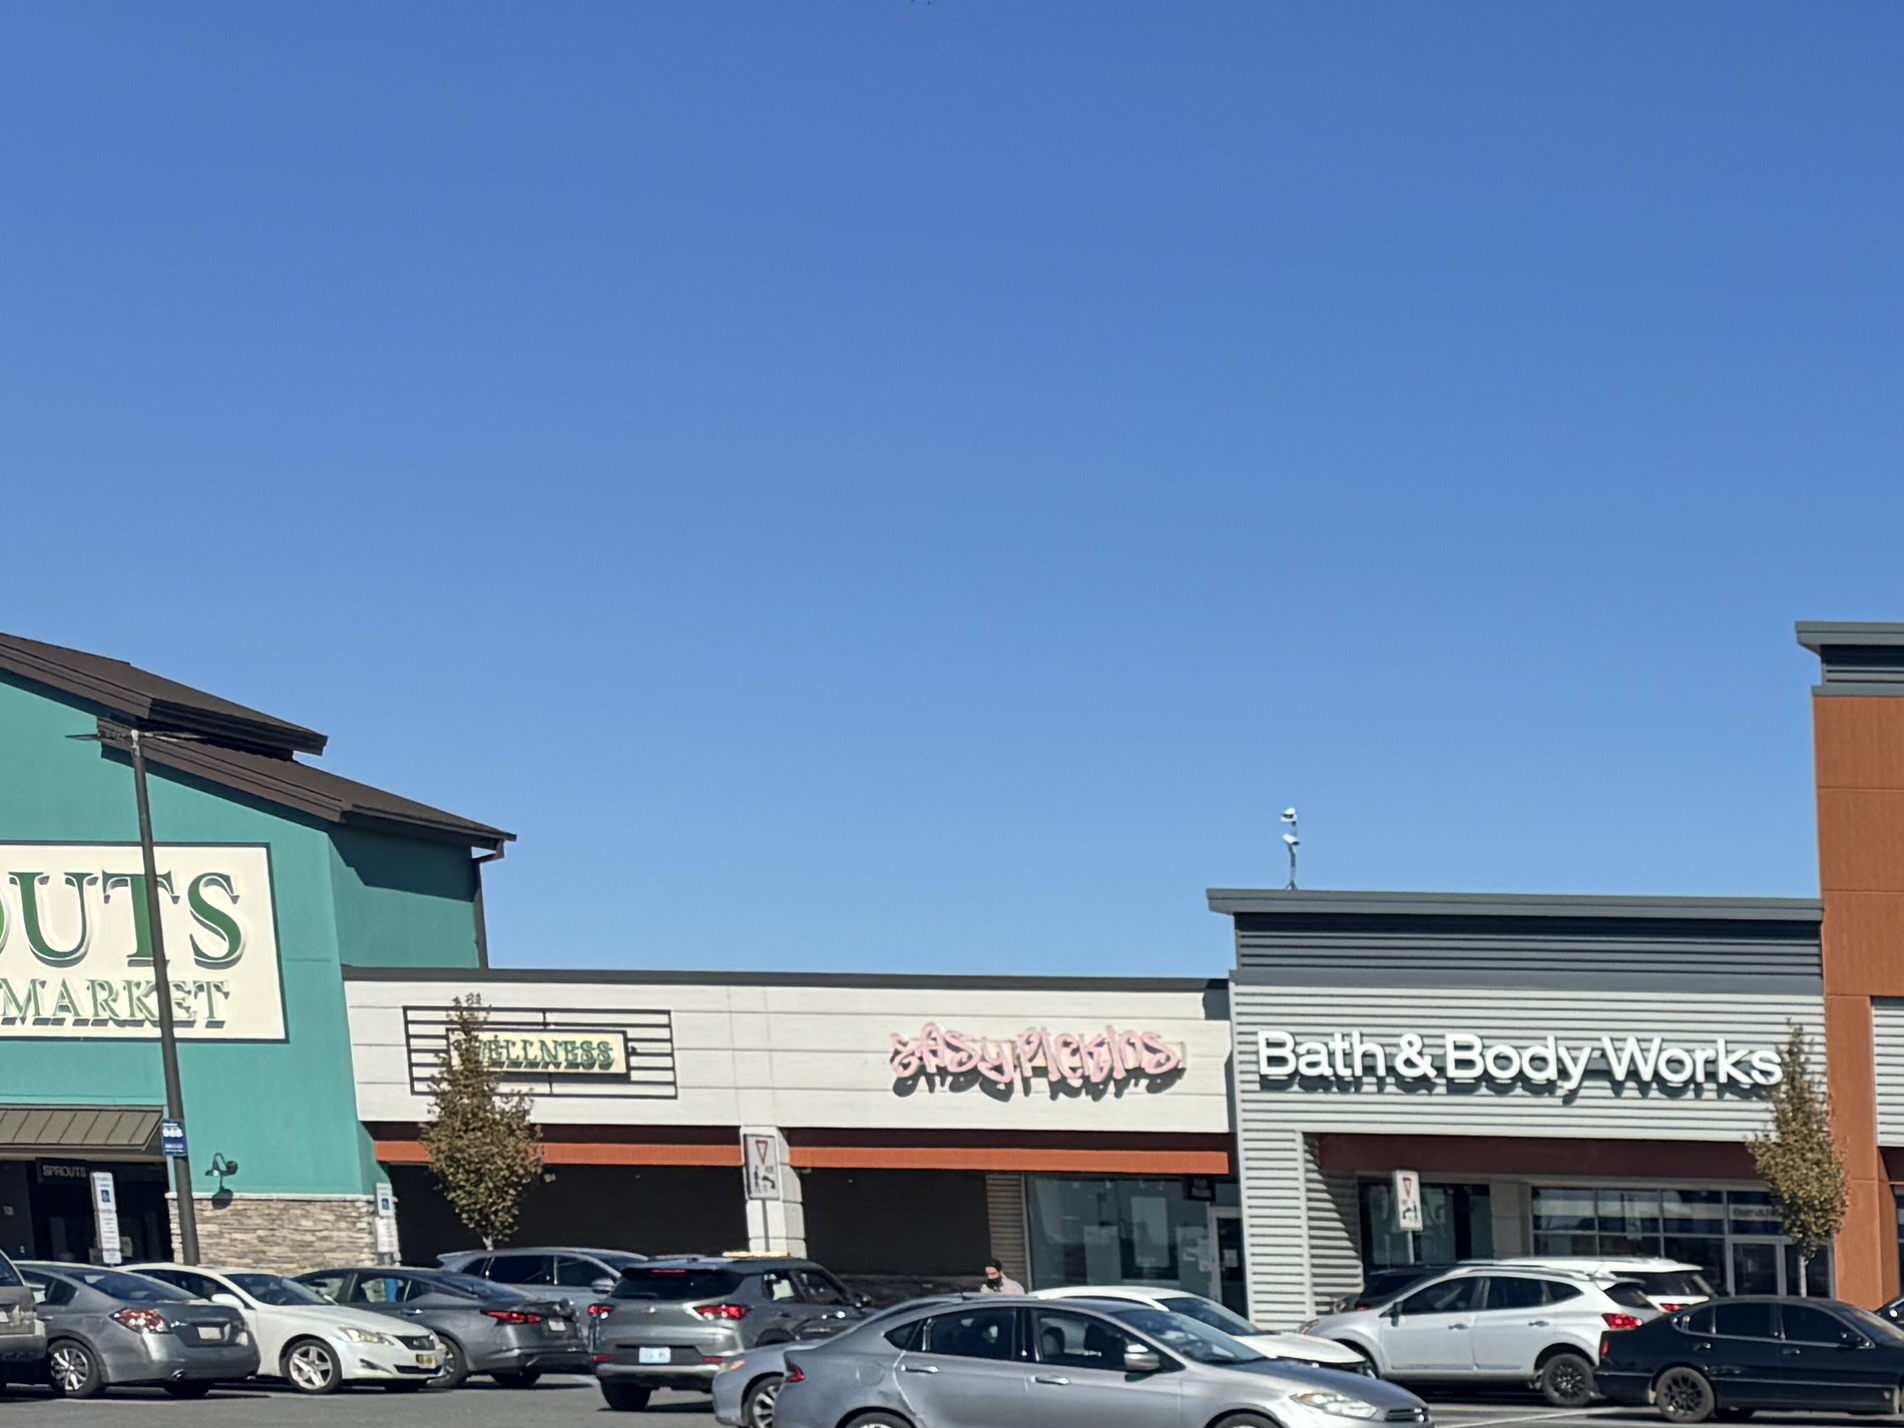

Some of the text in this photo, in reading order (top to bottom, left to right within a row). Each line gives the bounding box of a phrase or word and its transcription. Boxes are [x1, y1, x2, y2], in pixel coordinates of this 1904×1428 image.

[0, 868, 246, 970] UTS
[1256, 1029, 1784, 1090] Bath & Body Works
